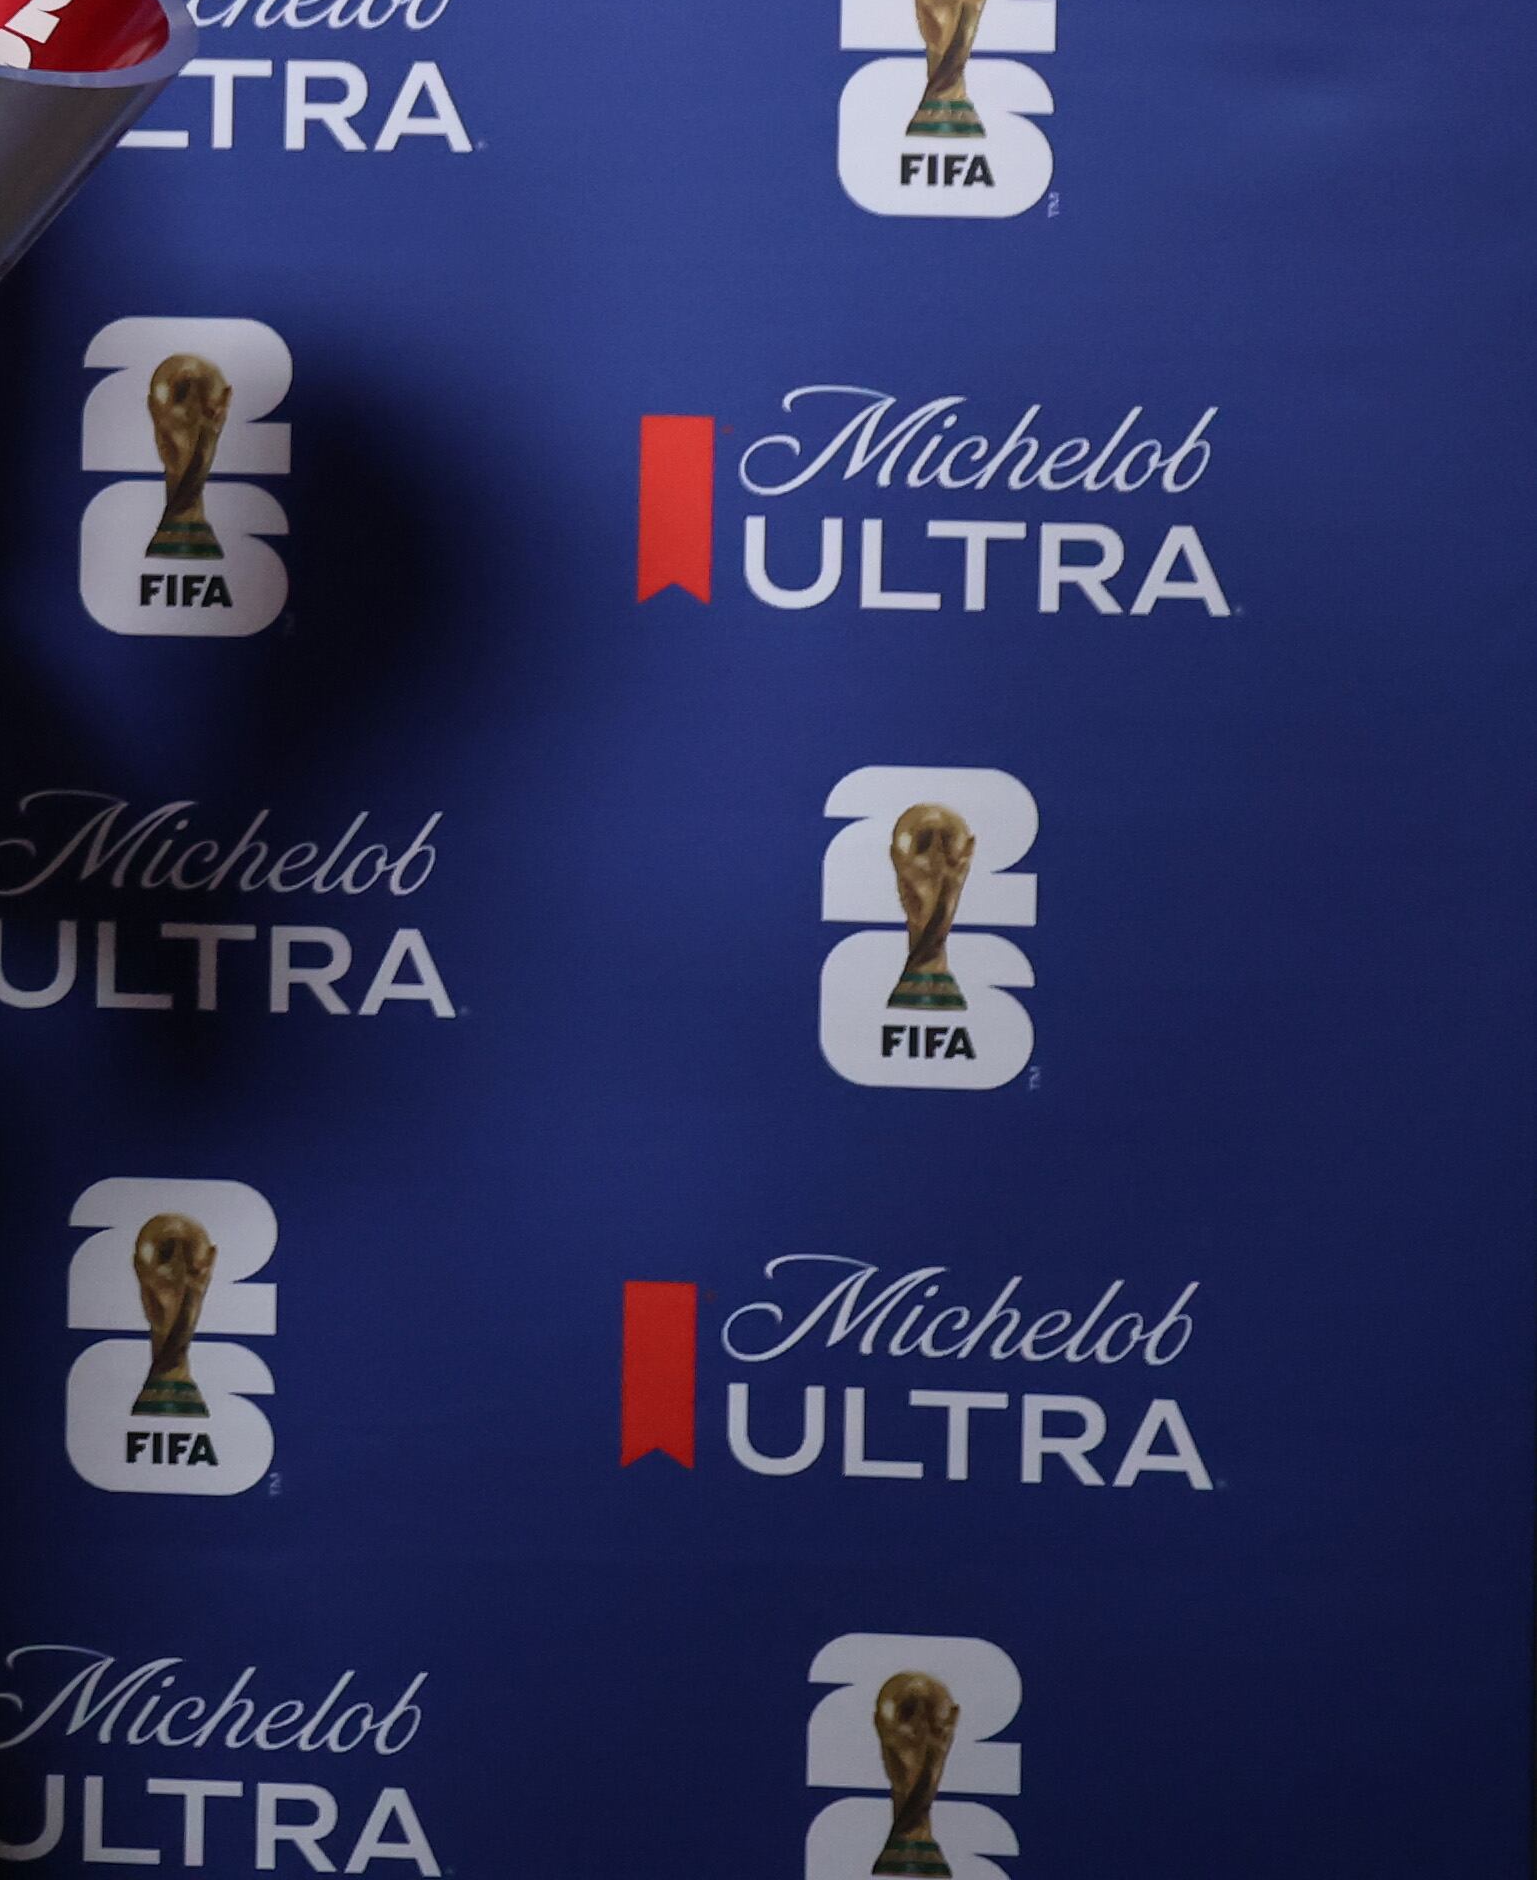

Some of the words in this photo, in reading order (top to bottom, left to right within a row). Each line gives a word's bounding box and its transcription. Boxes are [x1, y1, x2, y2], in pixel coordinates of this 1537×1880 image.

[116, 58, 473, 153] TRA
[900, 153, 994, 187] FIFA
[739, 385, 1218, 495] Michelob
[139, 573, 235, 609] FIFA
[744, 515, 1230, 616] ULTRA
[881, 1024, 976, 1060] FIFA
[721, 1254, 1200, 1365] Michelob
[125, 1430, 219, 1467] FIFA
[727, 1383, 1213, 1490] ULTRA
